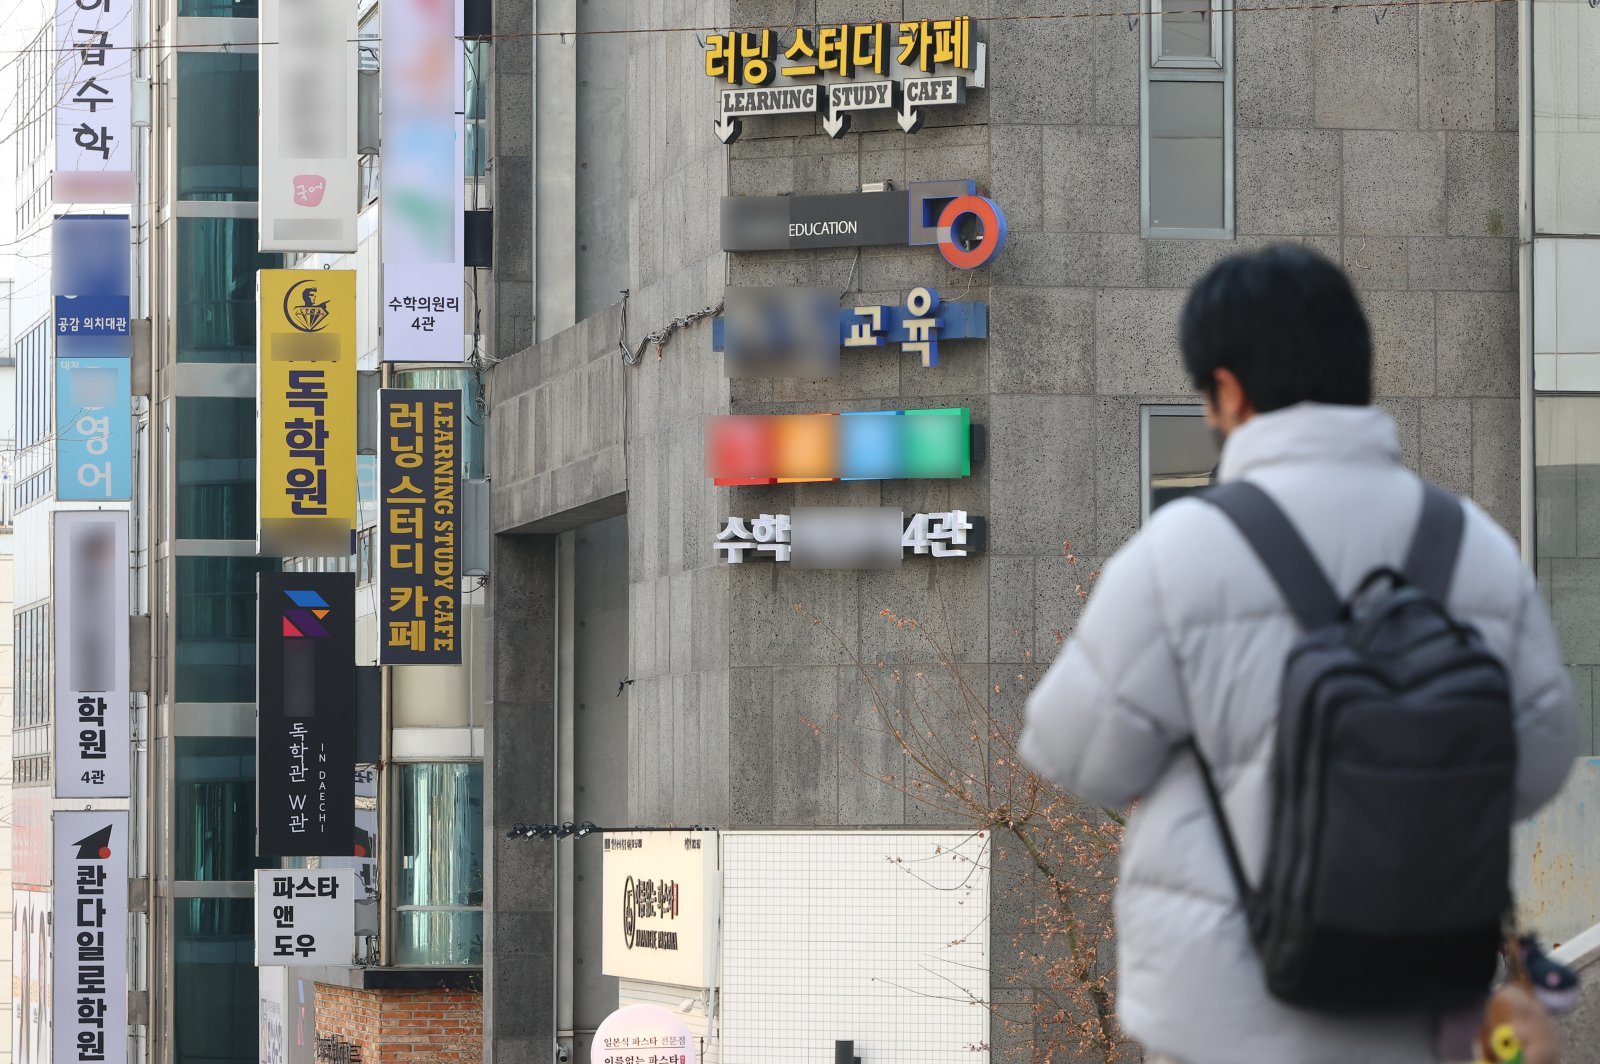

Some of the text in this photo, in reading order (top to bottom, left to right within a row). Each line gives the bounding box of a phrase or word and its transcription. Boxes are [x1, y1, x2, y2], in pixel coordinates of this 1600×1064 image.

[705, 15, 971, 85] 러닝 스터디 카페
[724, 80, 953, 112] LEARNING STUDY CAFE
[789, 220, 858, 237] EDUCATION
[388, 296, 459, 312] 수학의원리
[57, 317, 127, 332] 공감 의치대관
[411, 316, 435, 332] 4관
[844, 287, 941, 368] 교육
[284, 370, 330, 516] 독학원
[386, 401, 429, 652] 러닝 스터디 카페
[433, 401, 454, 652] LEARNING STUDY CAFE
[901, 510, 973, 558] 4관
[80, 769, 106, 785] 4관
[288, 722, 309, 833] 독학관 W관
[318, 742, 326, 833] IN DAECHI
[272, 876, 339, 899] 파스타
[273, 905, 294, 929] 앤
[273, 934, 316, 958] 도우
[76, 864, 107, 1062] 콴다일로학원
[632, 1036, 658, 1046] 파스타
